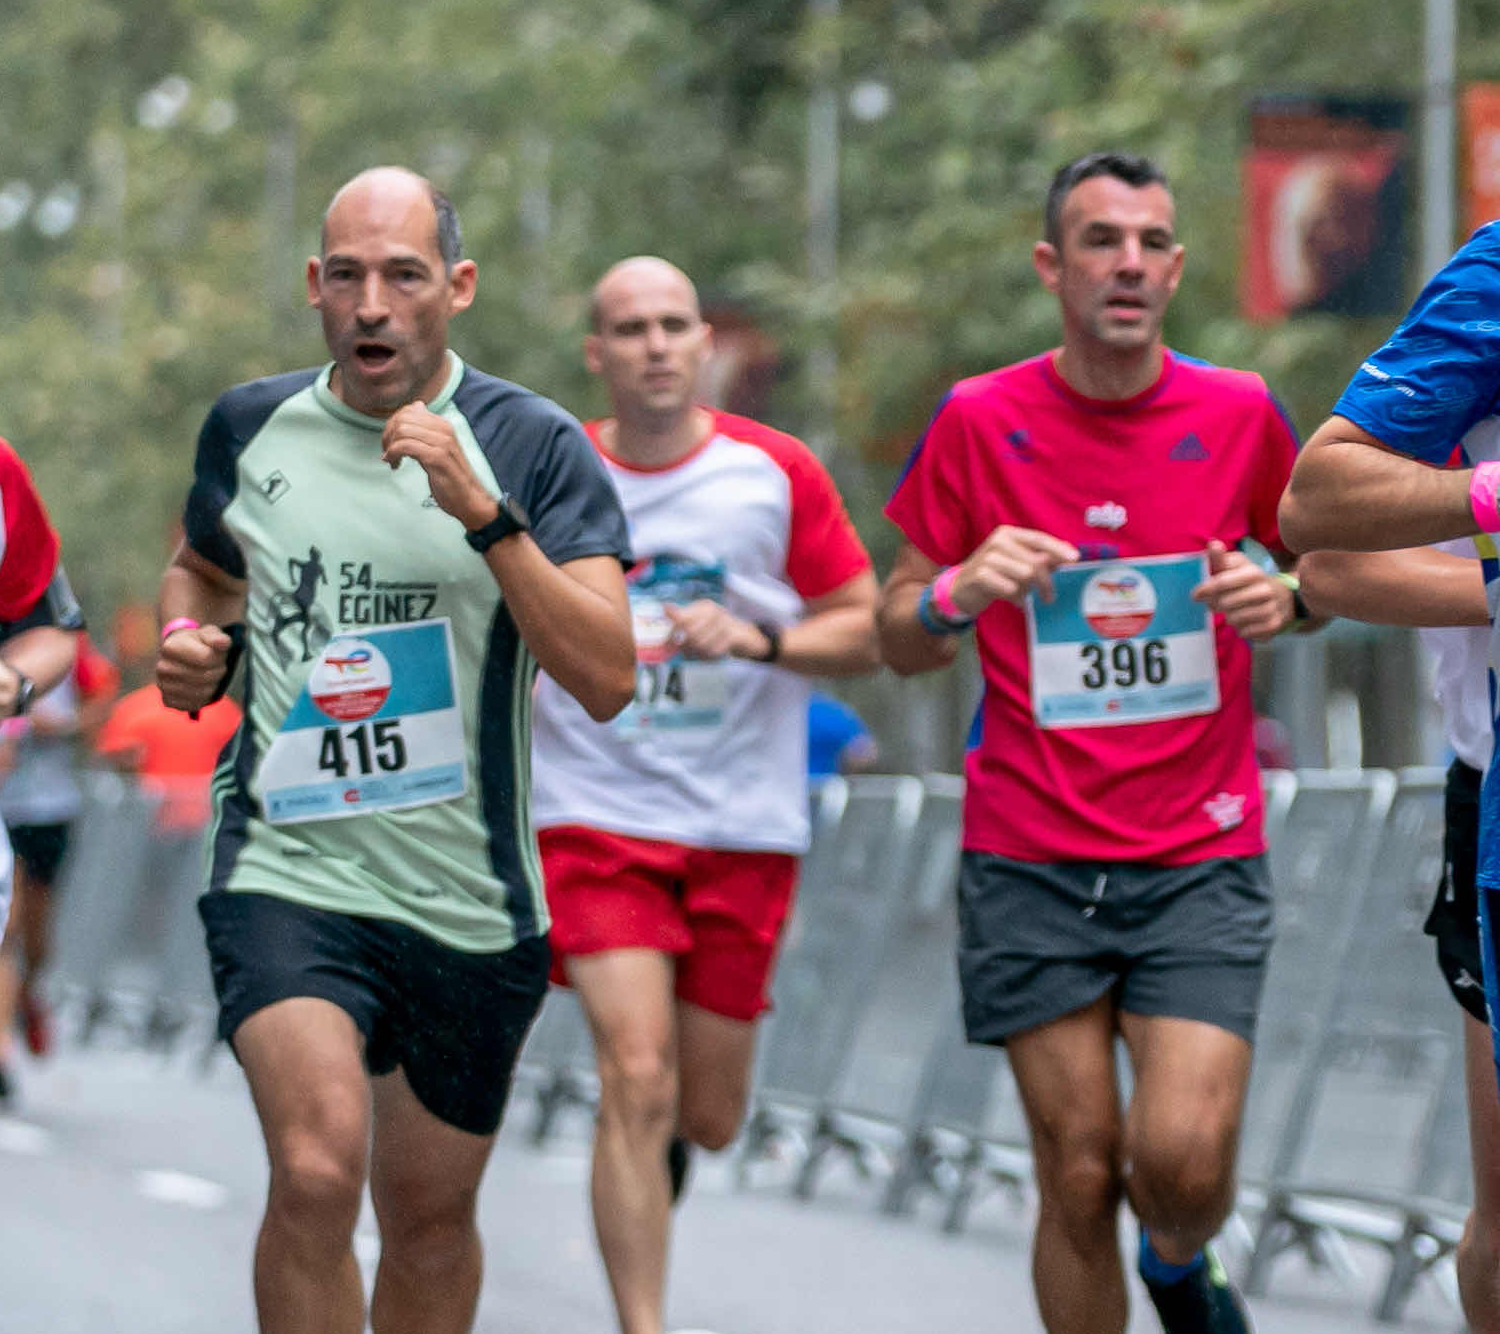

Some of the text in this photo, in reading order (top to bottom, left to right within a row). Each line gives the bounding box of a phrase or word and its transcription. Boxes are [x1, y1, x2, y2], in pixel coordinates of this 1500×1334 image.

[340, 562, 372, 590] 54
[339, 593, 437, 624] EGINEZ
[1080, 639, 1169, 689] 396
[318, 720, 407, 777] 415
